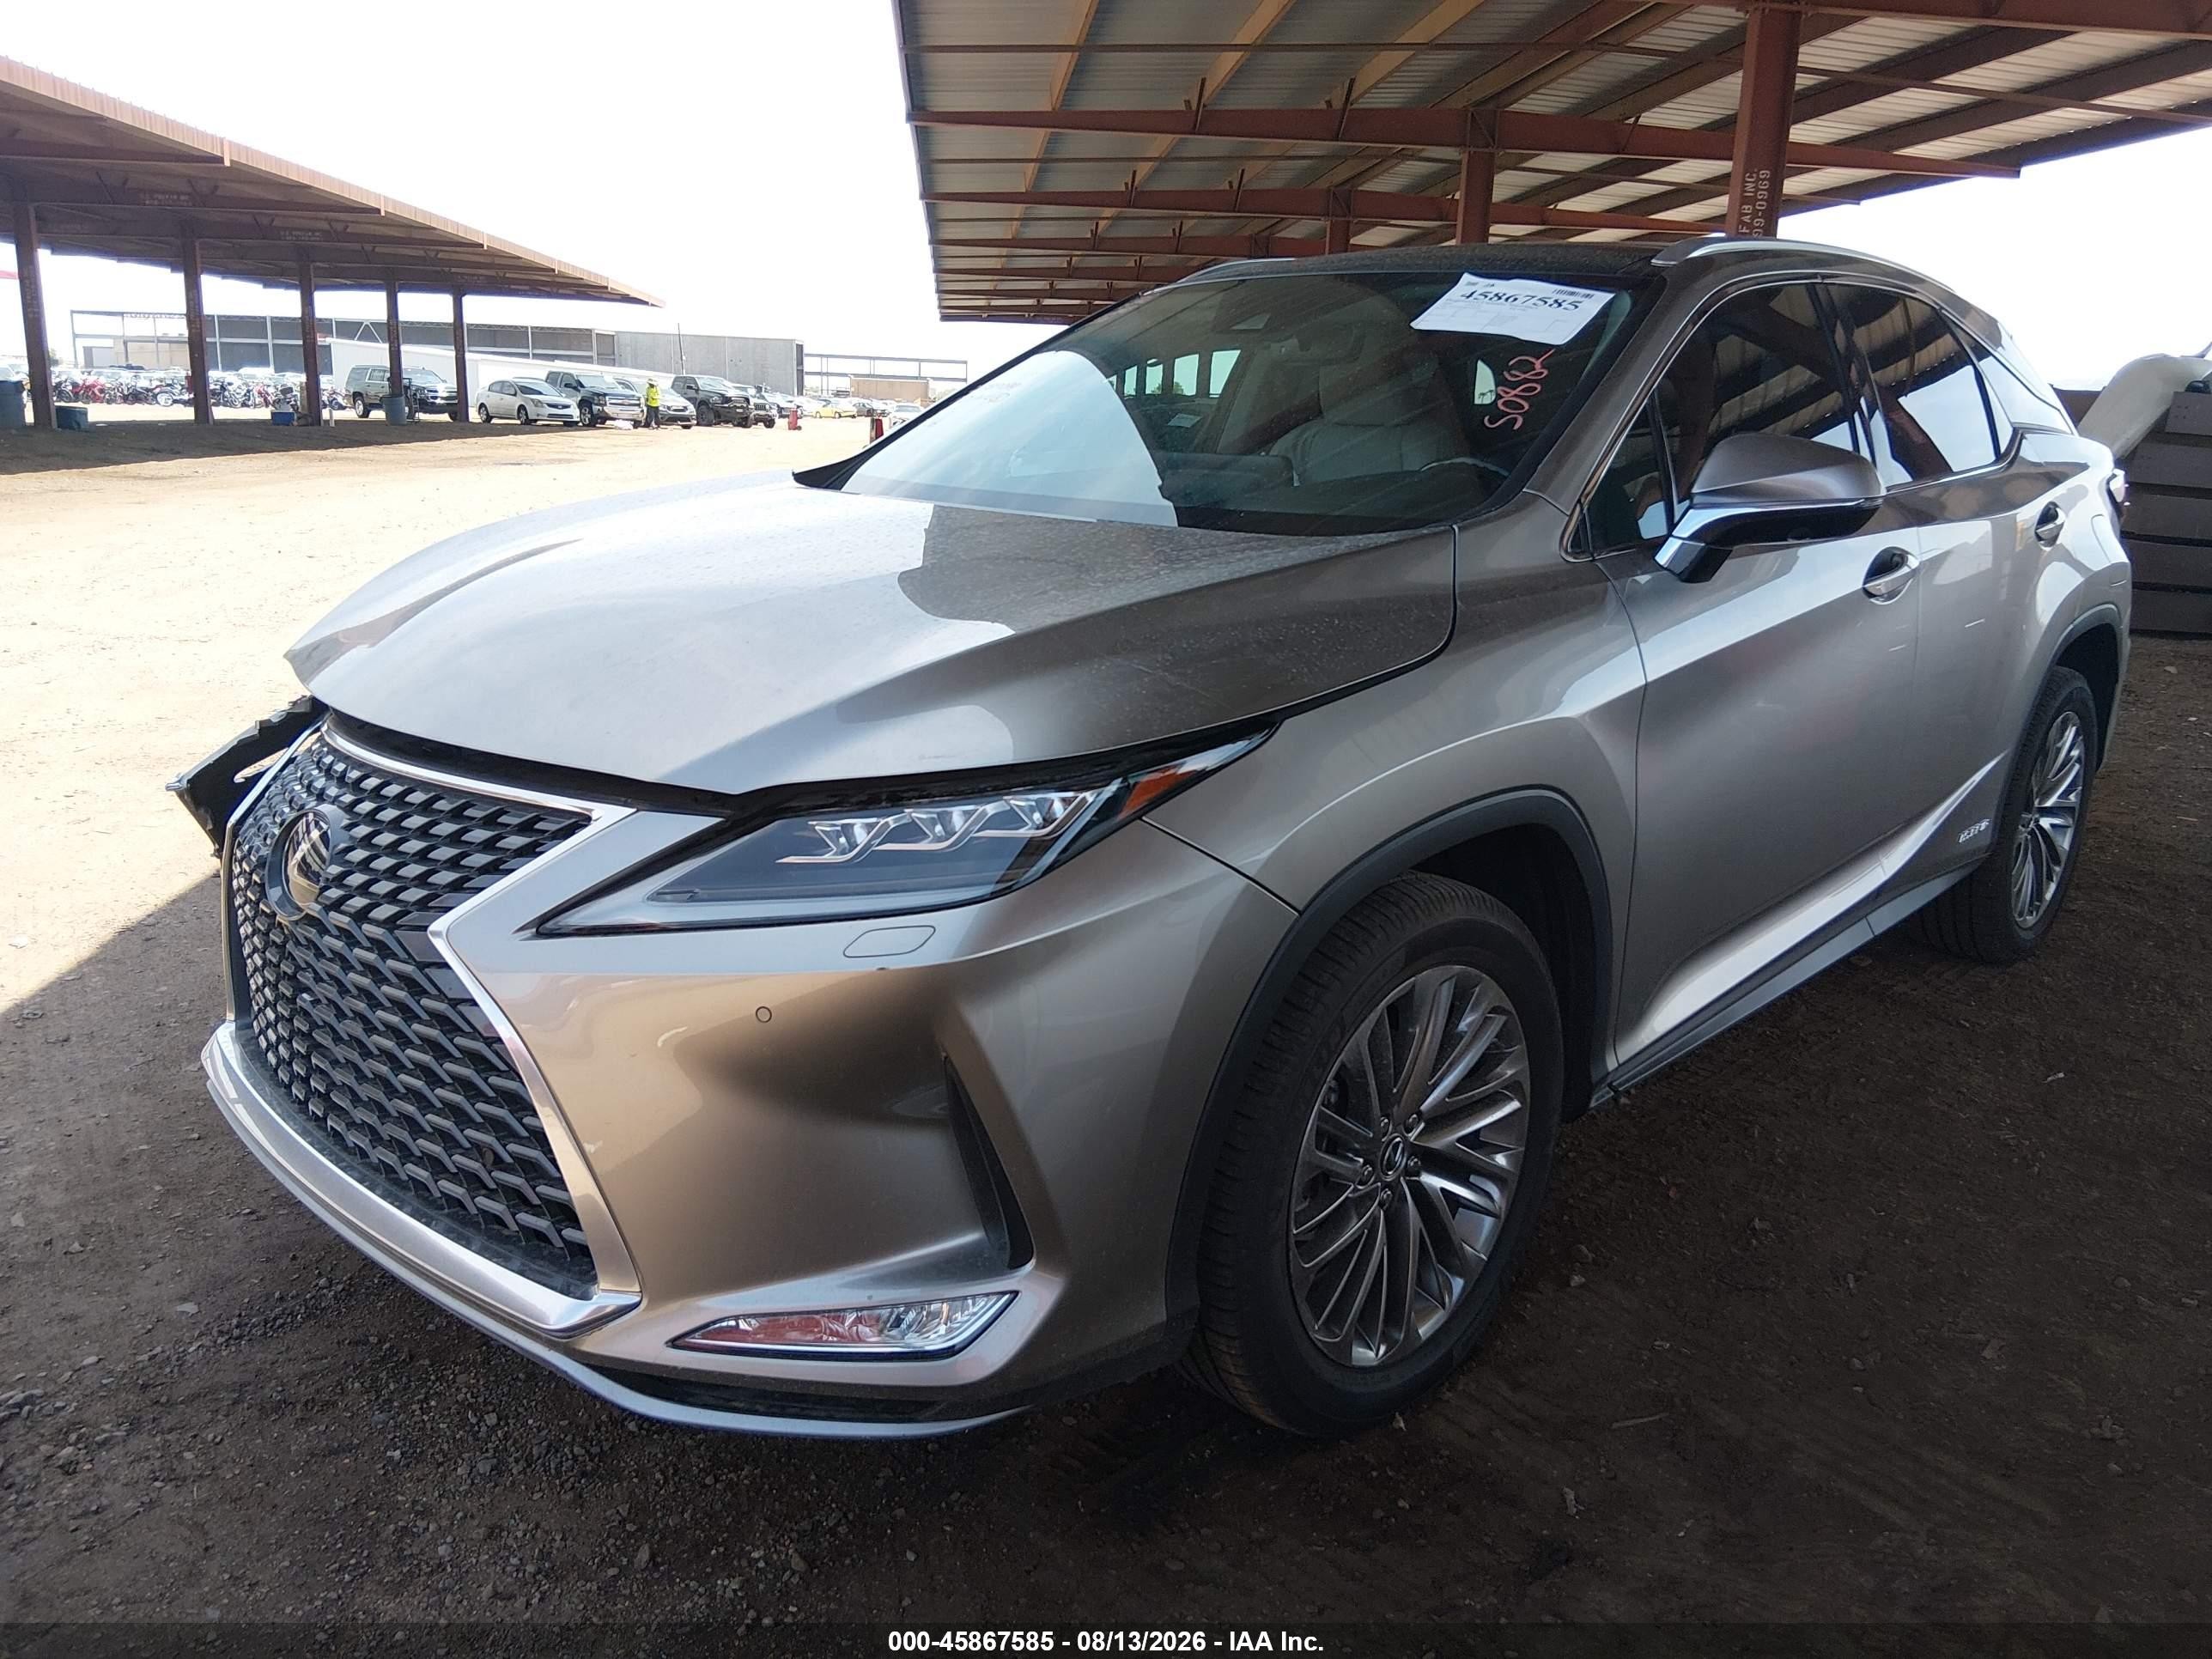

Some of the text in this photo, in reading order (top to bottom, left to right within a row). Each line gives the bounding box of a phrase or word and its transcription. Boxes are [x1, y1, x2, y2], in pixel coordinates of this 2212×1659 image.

[1738, 168, 1758, 234] FAB INC.
[1460, 289, 1583, 312] 45867585
